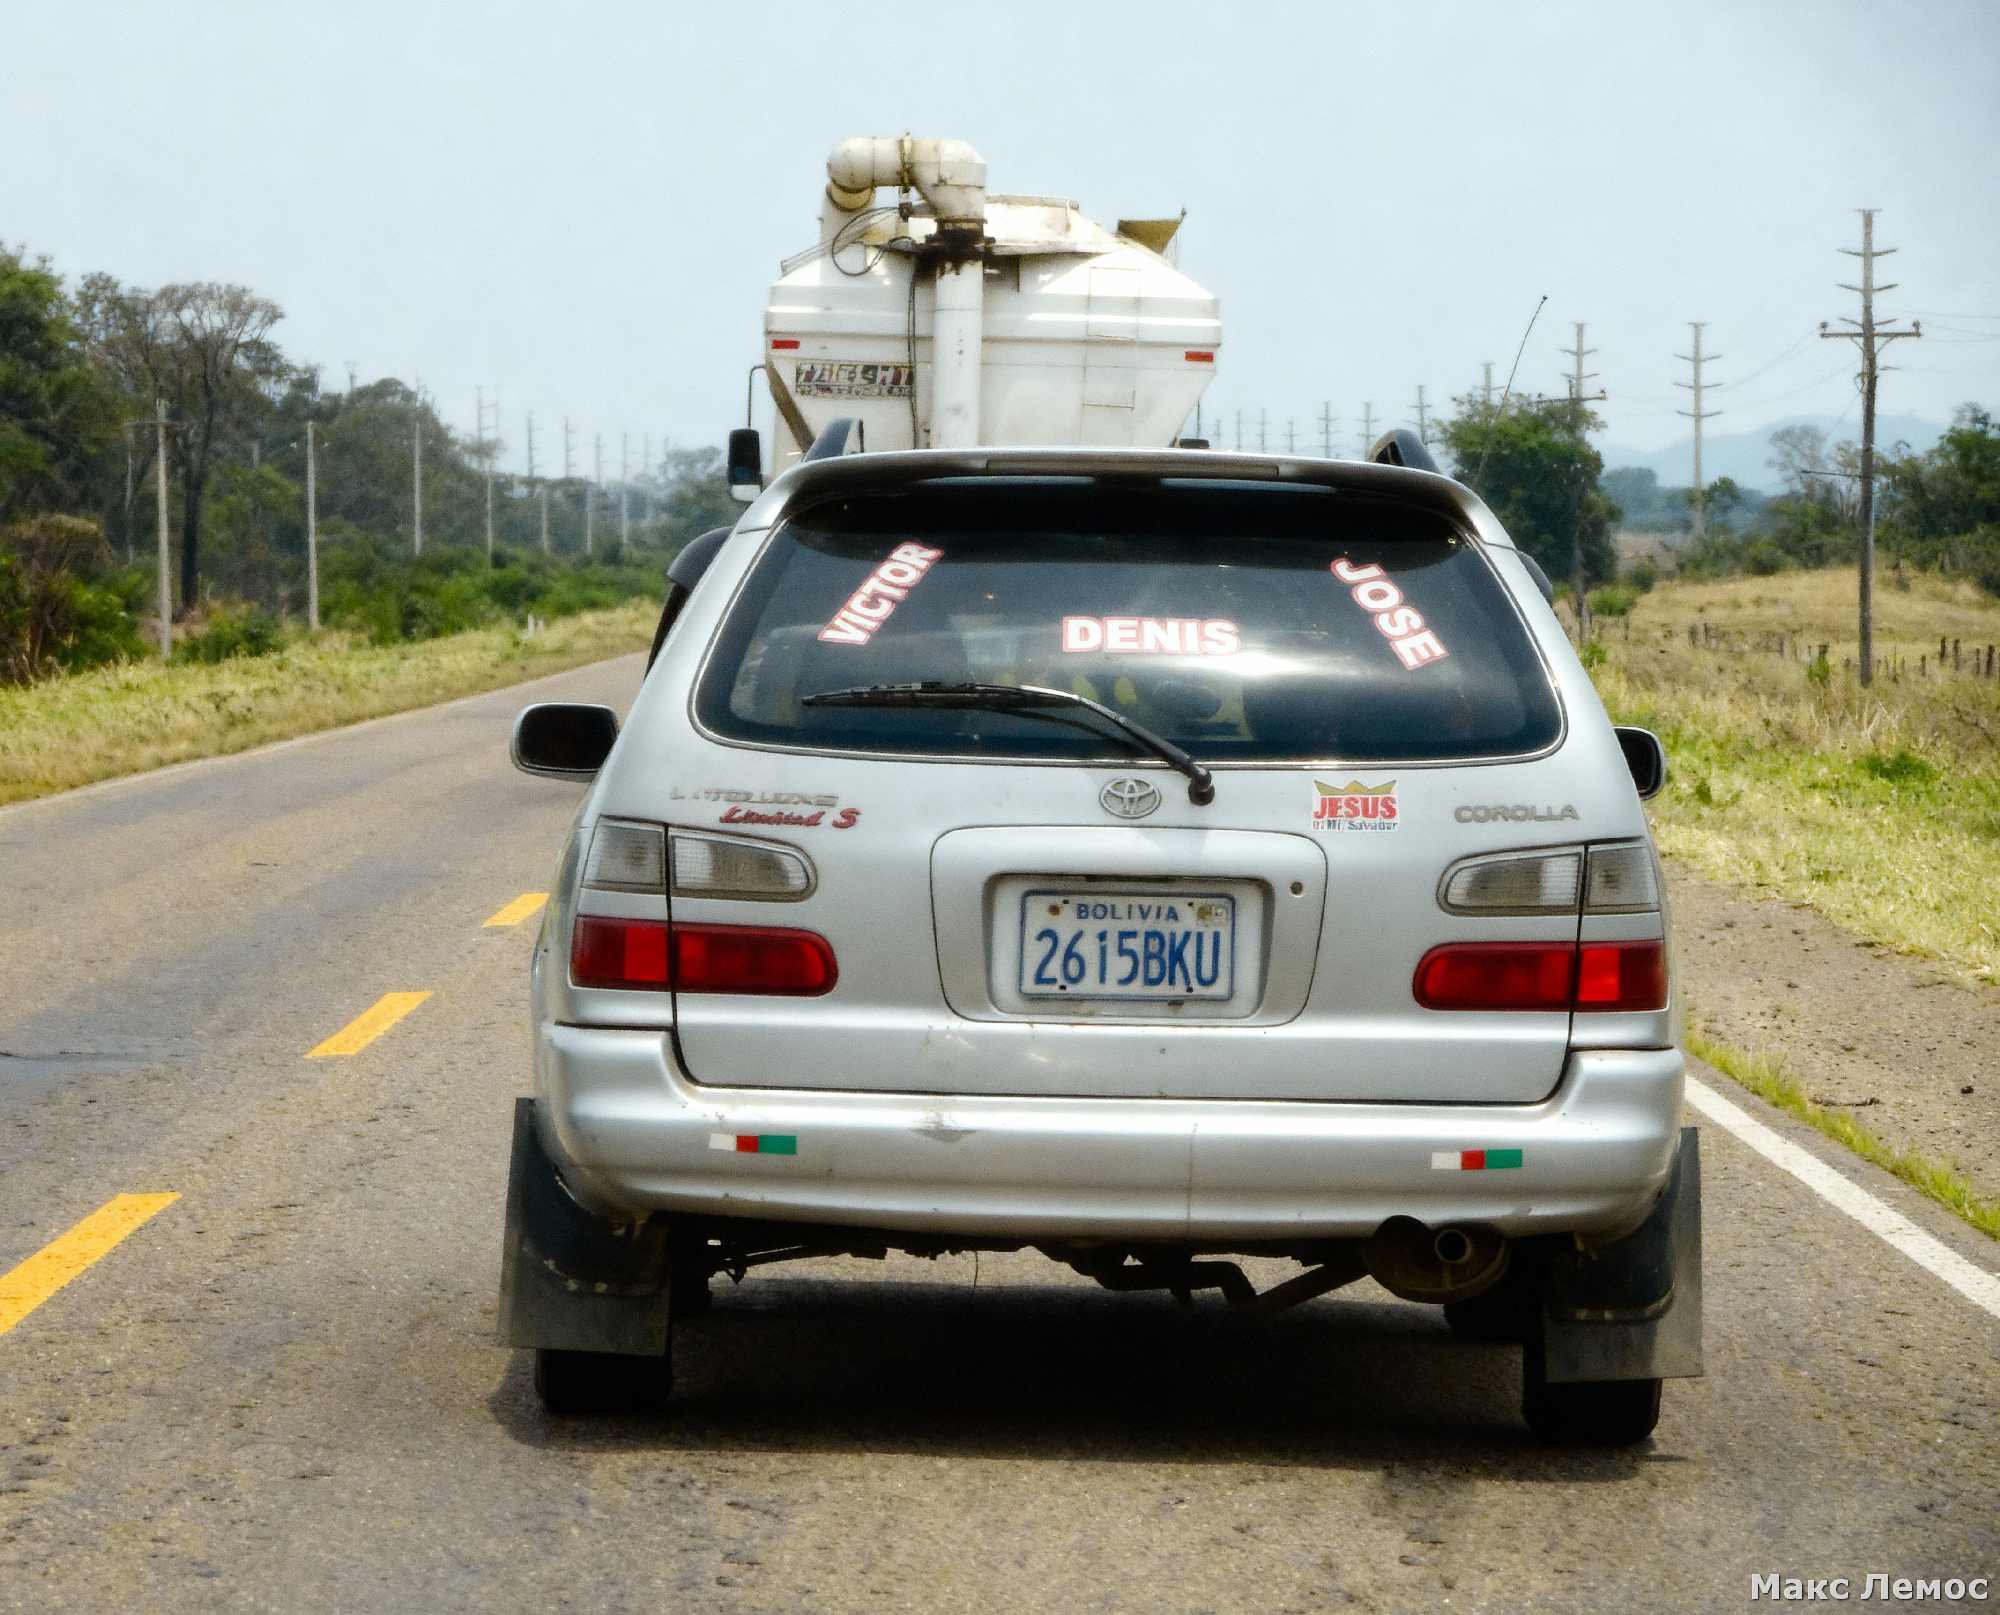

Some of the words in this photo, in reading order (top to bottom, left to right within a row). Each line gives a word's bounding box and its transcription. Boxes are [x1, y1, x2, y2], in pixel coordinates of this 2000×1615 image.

[817, 540, 944, 645] VICTOR
[1330, 556, 1449, 670] JOSE
[1062, 616, 1241, 654] DENIS
[832, 807, 862, 829] S
[1313, 796, 1397, 820] JESUS
[1454, 804, 1580, 824] COROLLA
[1076, 903, 1179, 922] BOLIVIA
[1034, 928, 1221, 987] 2615BKU
